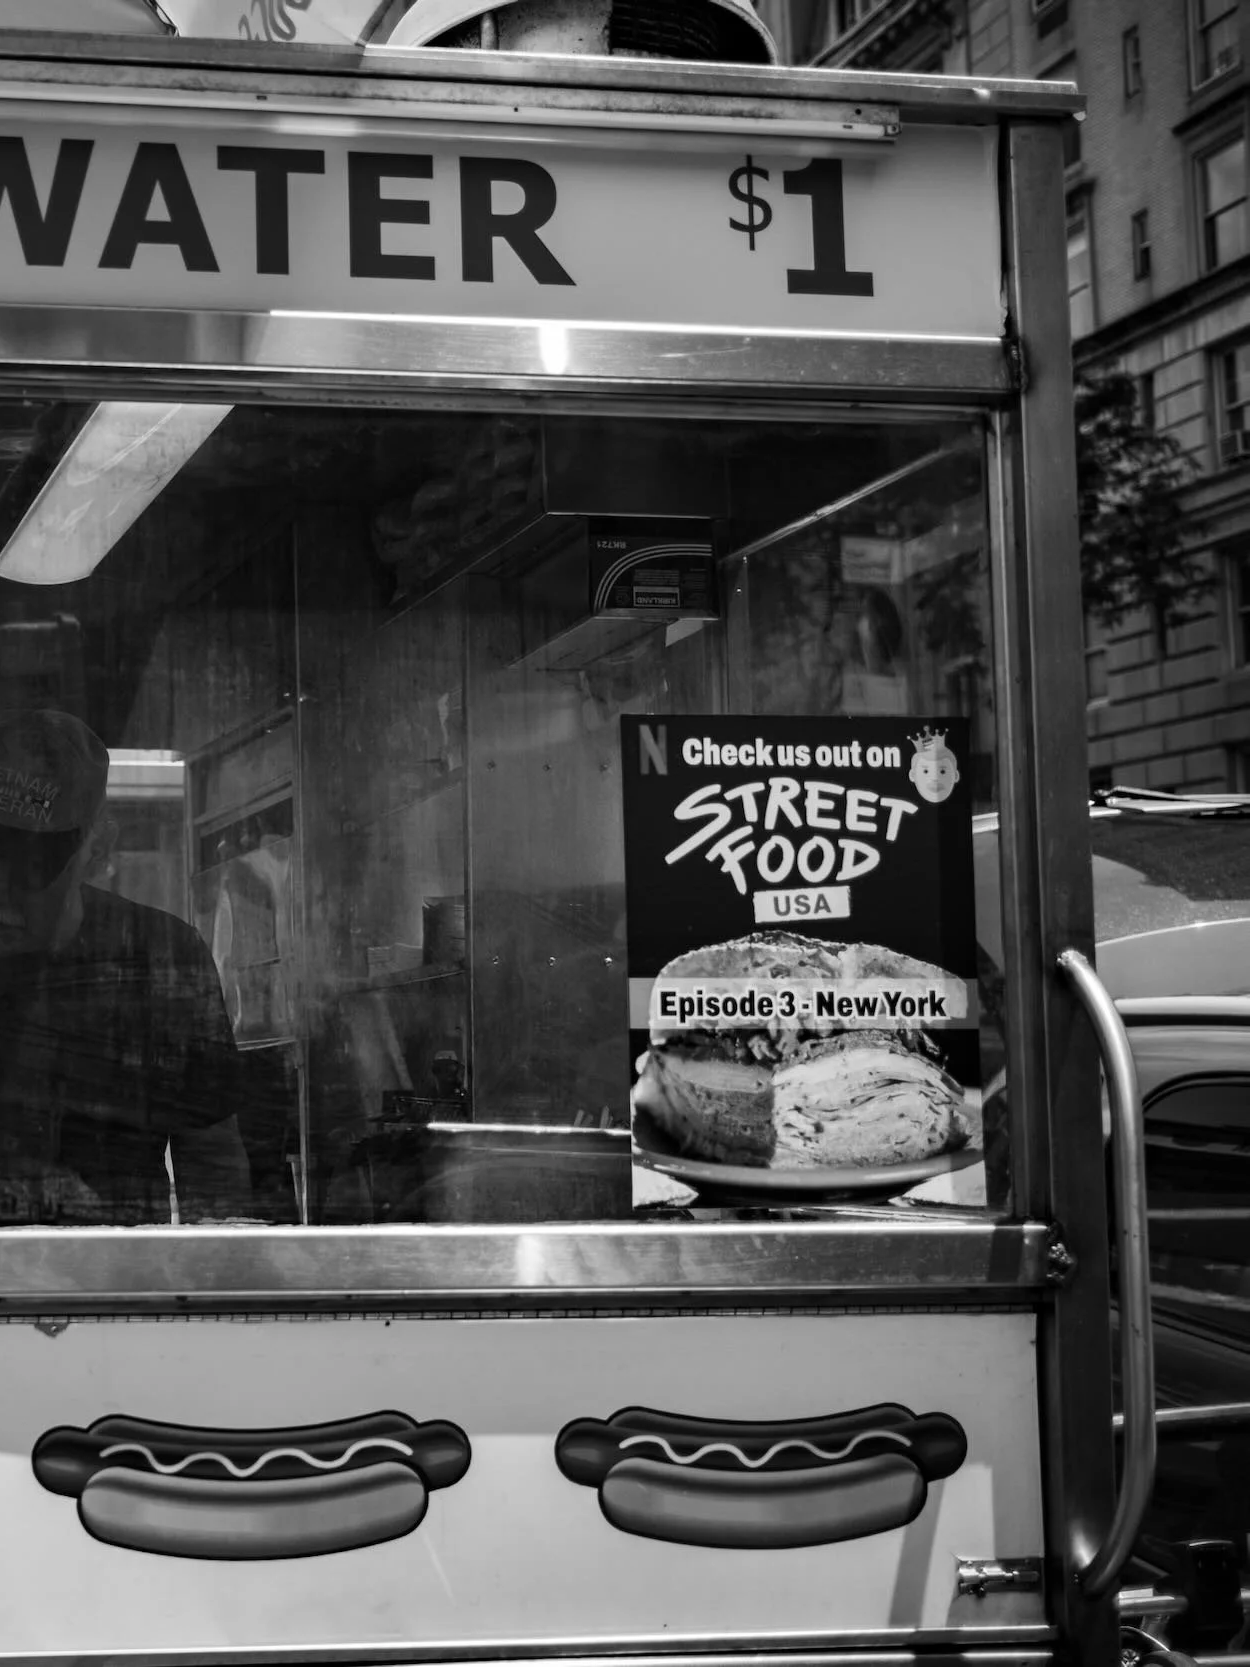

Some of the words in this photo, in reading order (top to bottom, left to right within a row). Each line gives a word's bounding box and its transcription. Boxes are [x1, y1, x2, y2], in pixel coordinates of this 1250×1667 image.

[727, 154, 874, 296] $1
[639, 724, 668, 775] N
[682, 737, 774, 767] Check
[777, 743, 811, 767] us
[815, 740, 862, 768] out
[866, 745, 901, 768] on
[664, 776, 918, 865] STREET
[705, 825, 881, 895] FOOD
[772, 893, 832, 917] USA
[659, 990, 773, 1023] Episode
[779, 990, 796, 1018] 3
[816, 990, 878, 1018] New
[882, 990, 947, 1018] York
